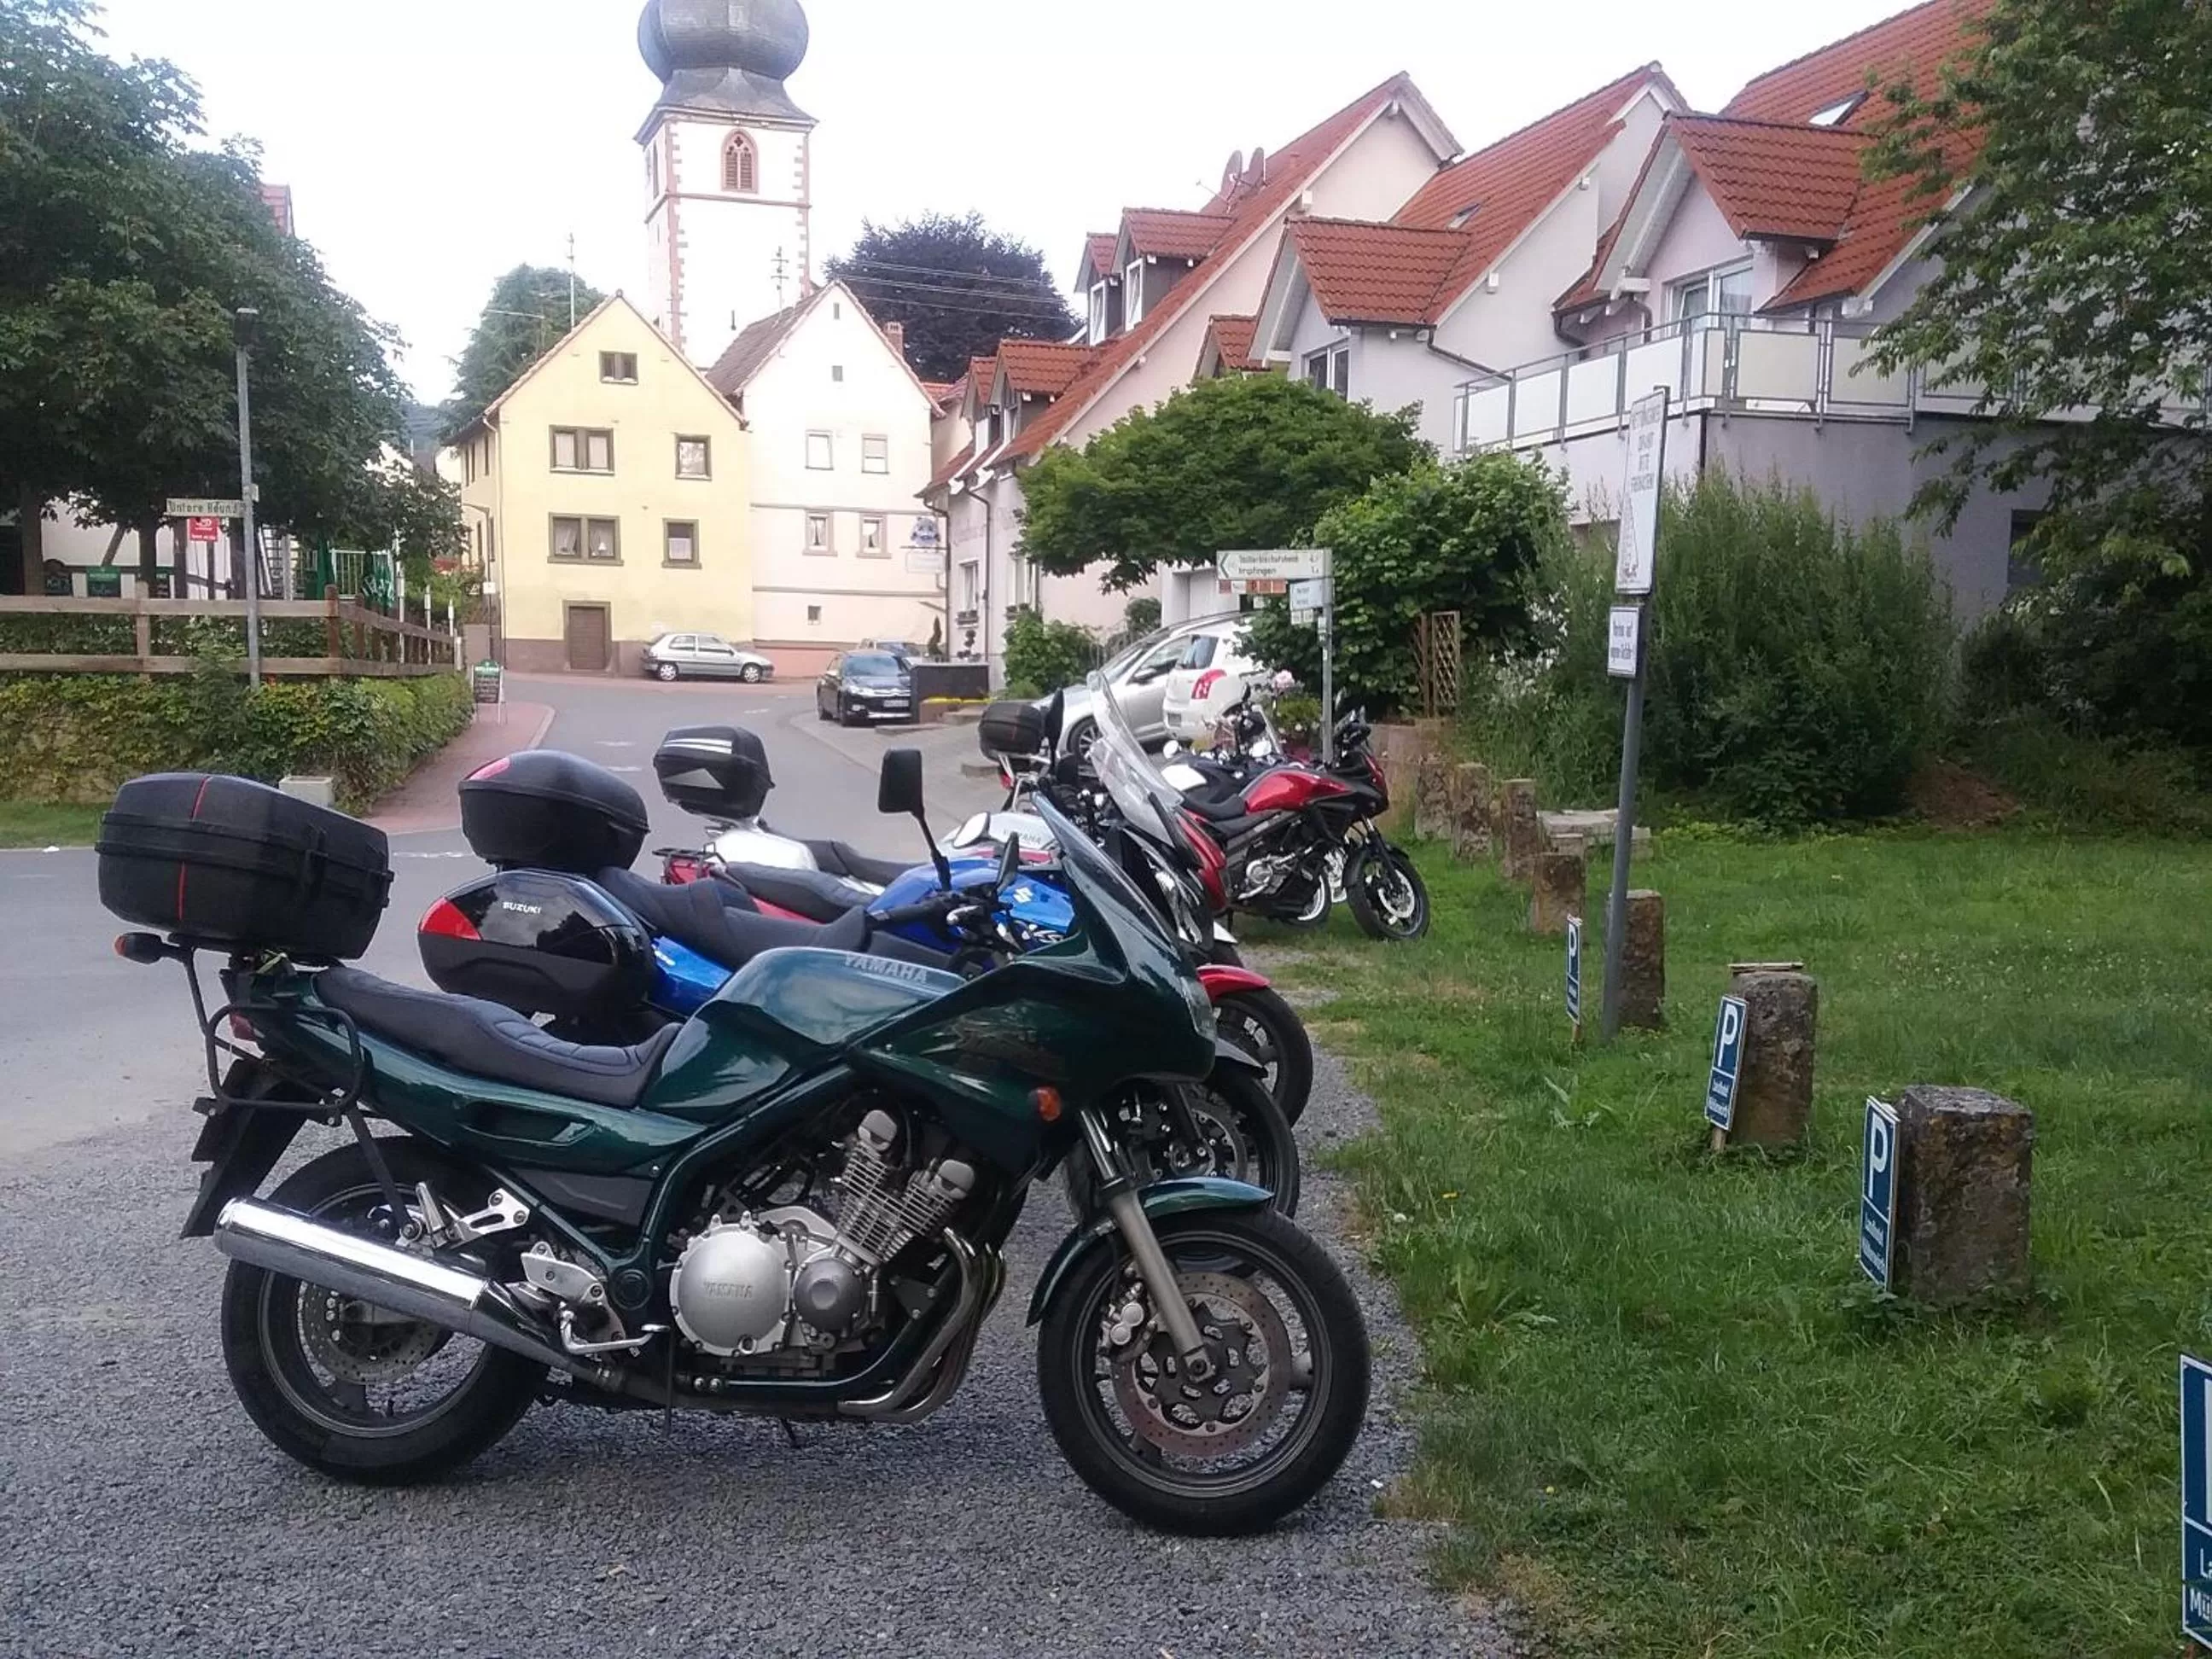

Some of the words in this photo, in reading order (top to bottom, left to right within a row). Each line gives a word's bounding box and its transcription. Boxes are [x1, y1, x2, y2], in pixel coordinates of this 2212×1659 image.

[502, 901, 542, 915] SUZUKI
[845, 953, 927, 985] YAMAHA
[1569, 923, 1577, 974] P
[1717, 1004, 1738, 1068] P
[1867, 1110, 1889, 1200] P
